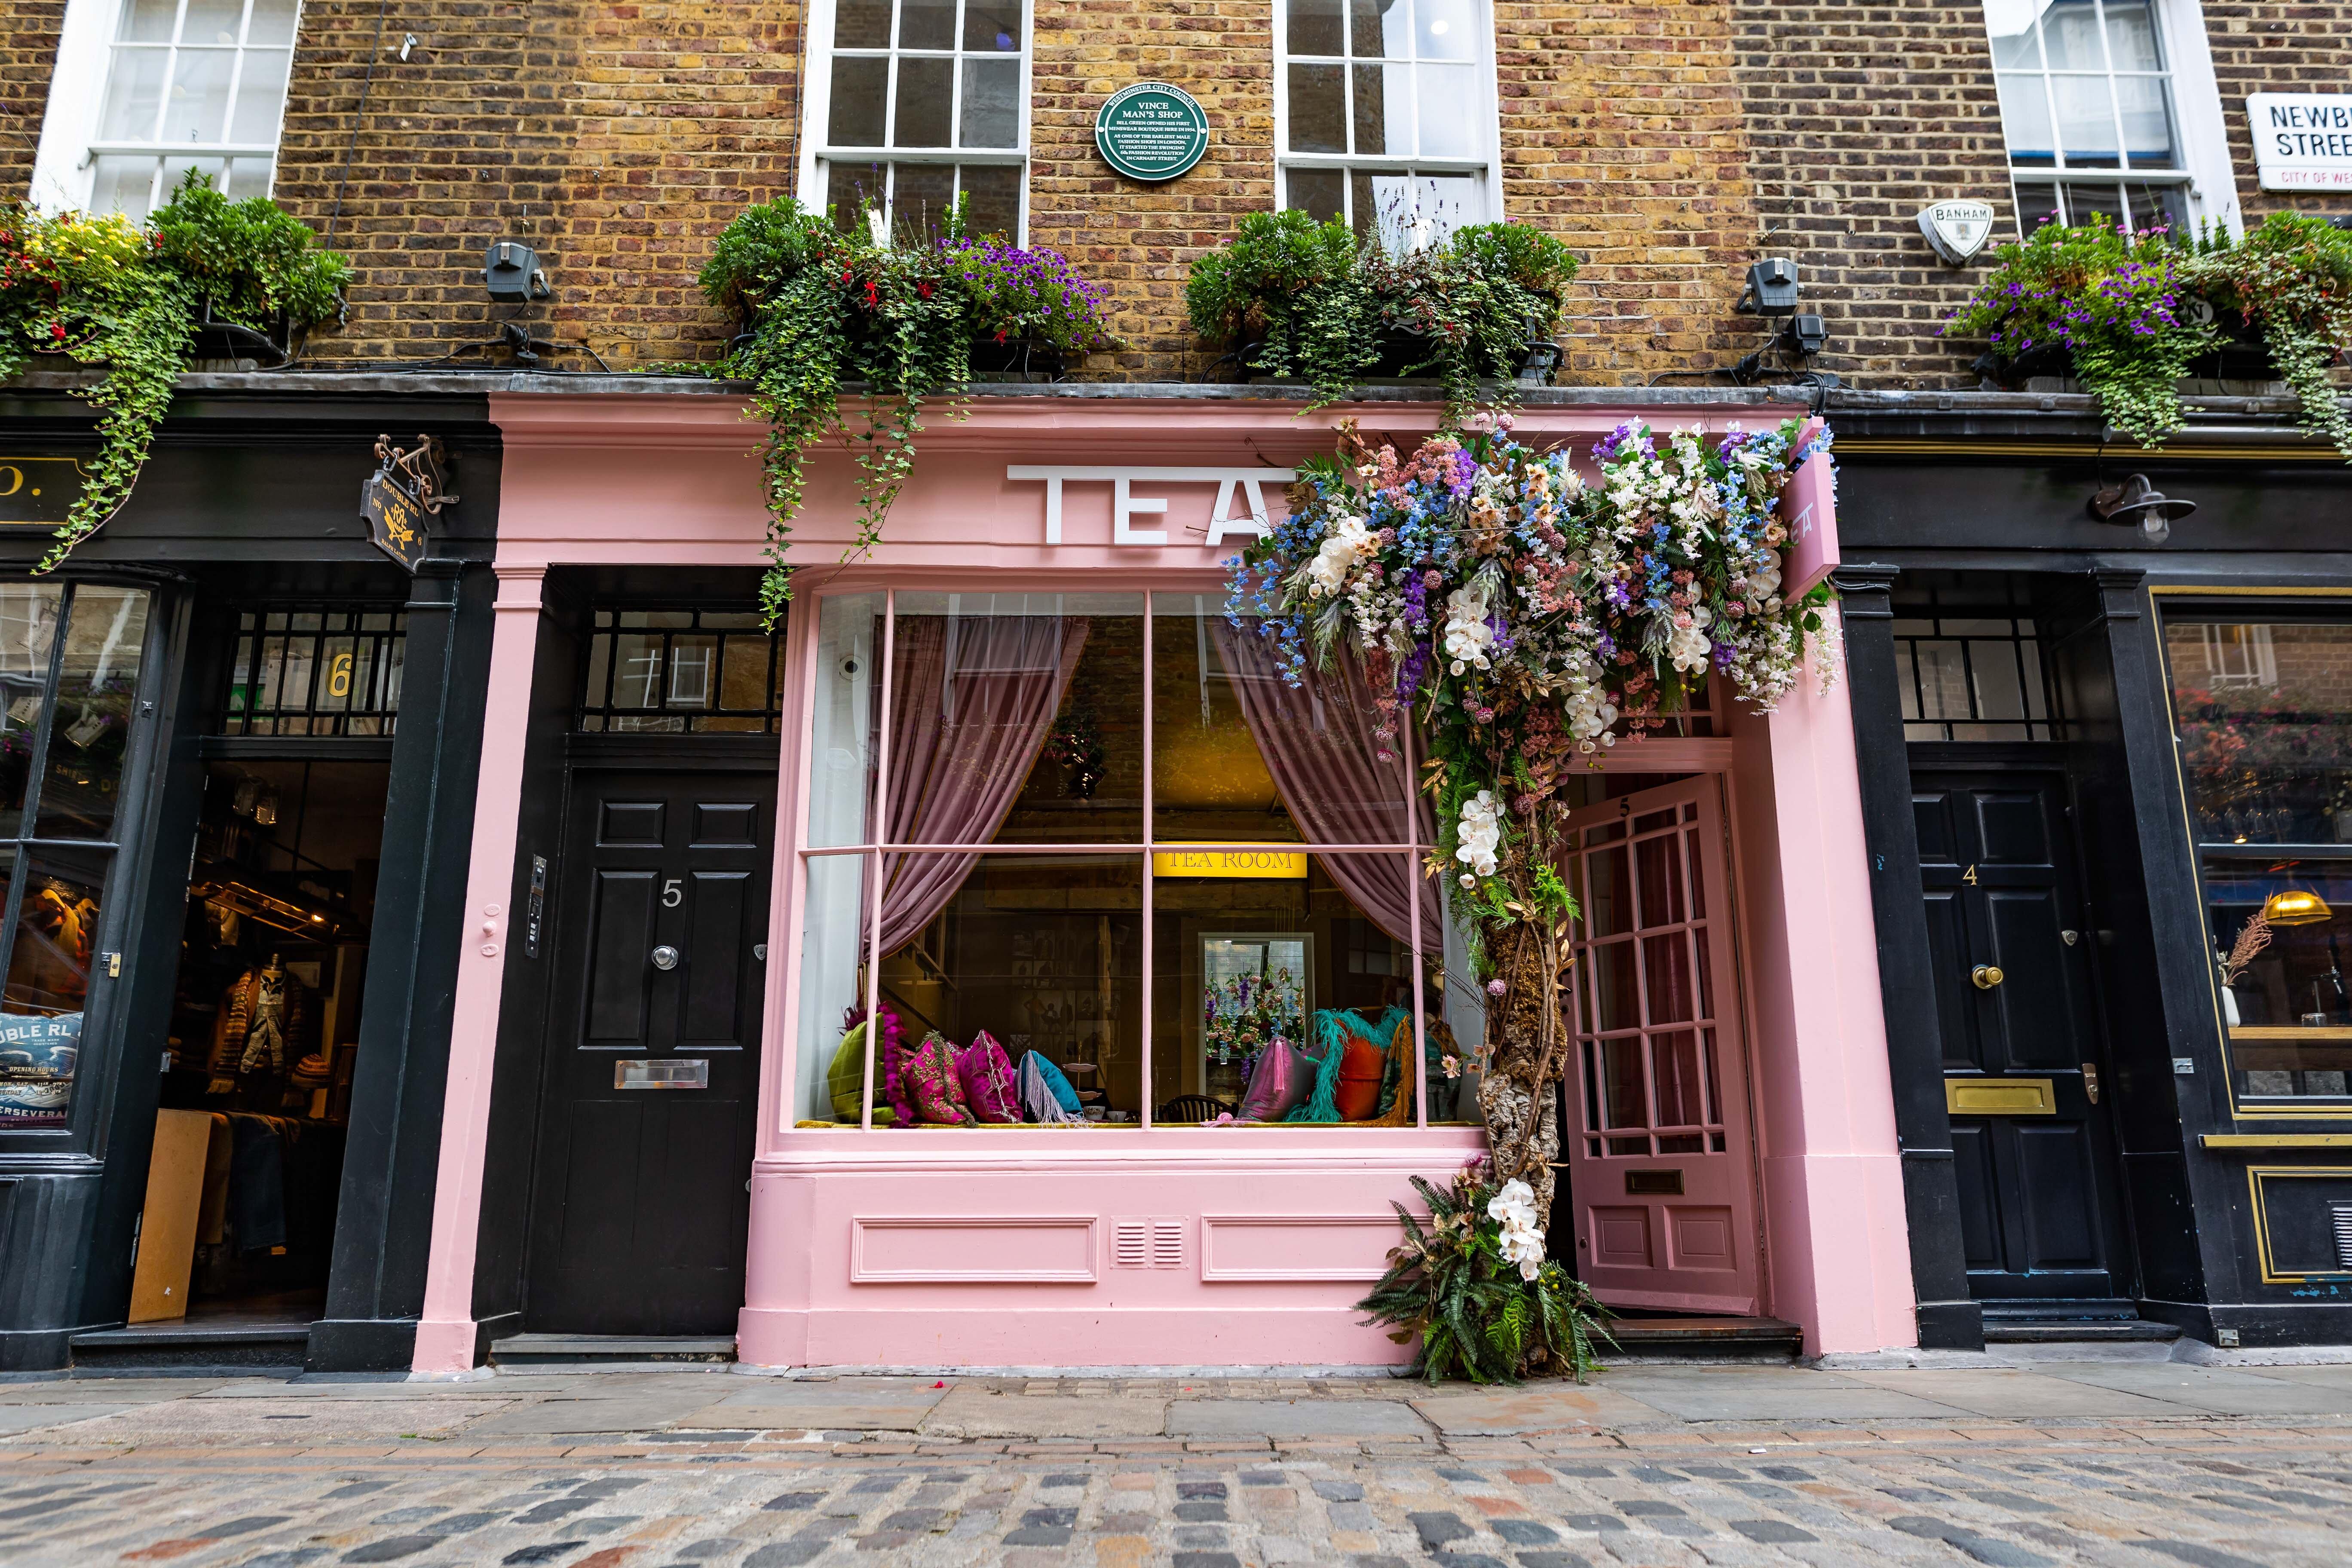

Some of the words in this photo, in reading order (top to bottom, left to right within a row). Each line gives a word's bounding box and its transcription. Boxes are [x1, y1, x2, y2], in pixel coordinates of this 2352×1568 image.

[1108, 85, 1151, 107] WESTMINSTER
[1169, 88, 1196, 107] COUNCIL
[2270, 106, 2352, 128] NEWB
[2282, 172, 2307, 183] CITY
[2313, 173, 2328, 183] OF
[1936, 208, 1987, 220] BANHAM
[383, 479, 409, 508] DOUBLE
[410, 505, 419, 517] RL
[1007, 465, 1296, 546] TEA
[1791, 502, 1813, 544] EA
[382, 538, 394, 552] RALPH
[394, 549, 408, 562] LAUREN
[418, 537, 422, 546] 6
[326, 653, 353, 698] 6
[1620, 797, 1630, 818] 5
[1166, 853, 1213, 867] TEA
[1221, 853, 1292, 868] ROOM
[1963, 864, 1977, 885] 4
[662, 879, 682, 907] 5
[48, 1024, 71, 1036] RL
[0, 1106, 67, 1118] ERSEVERA
